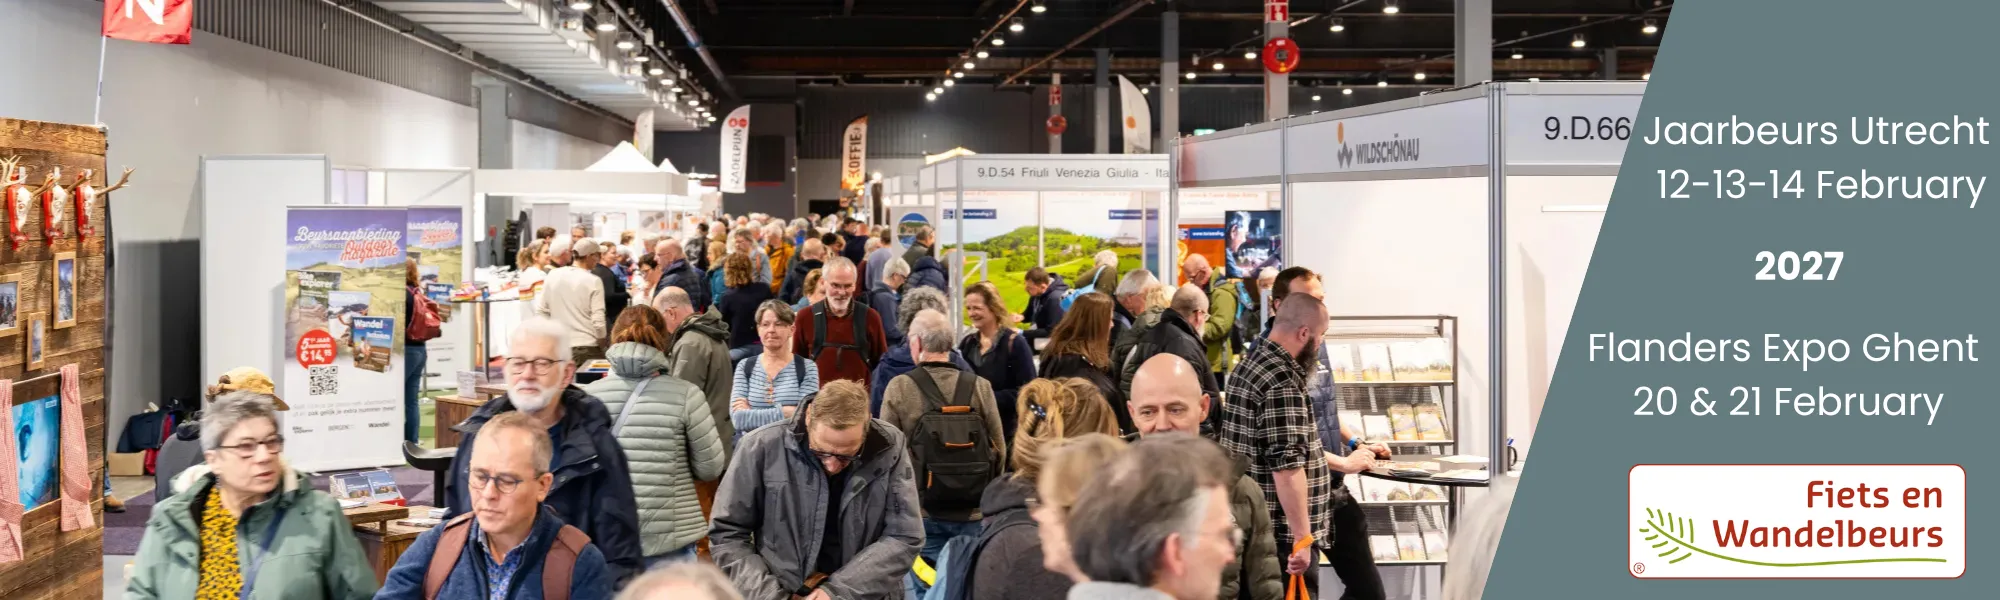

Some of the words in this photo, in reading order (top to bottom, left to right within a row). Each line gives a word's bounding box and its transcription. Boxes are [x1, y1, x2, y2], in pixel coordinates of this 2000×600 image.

[1544, 116, 1631, 140] 9.D.66
[730, 128, 742, 185] ZADELPIJN
[1356, 133, 1420, 165] WILDSCHÖNAU
[977, 167, 1015, 178] 9.D.54
[1021, 167, 1049, 178] Friuli
[1055, 167, 1100, 178] Venezia
[1106, 167, 1139, 178] Giulia
[294, 226, 402, 243] Beursaanbieding
[340, 246, 399, 264] magazine
[353, 319, 384, 329] Wandel
